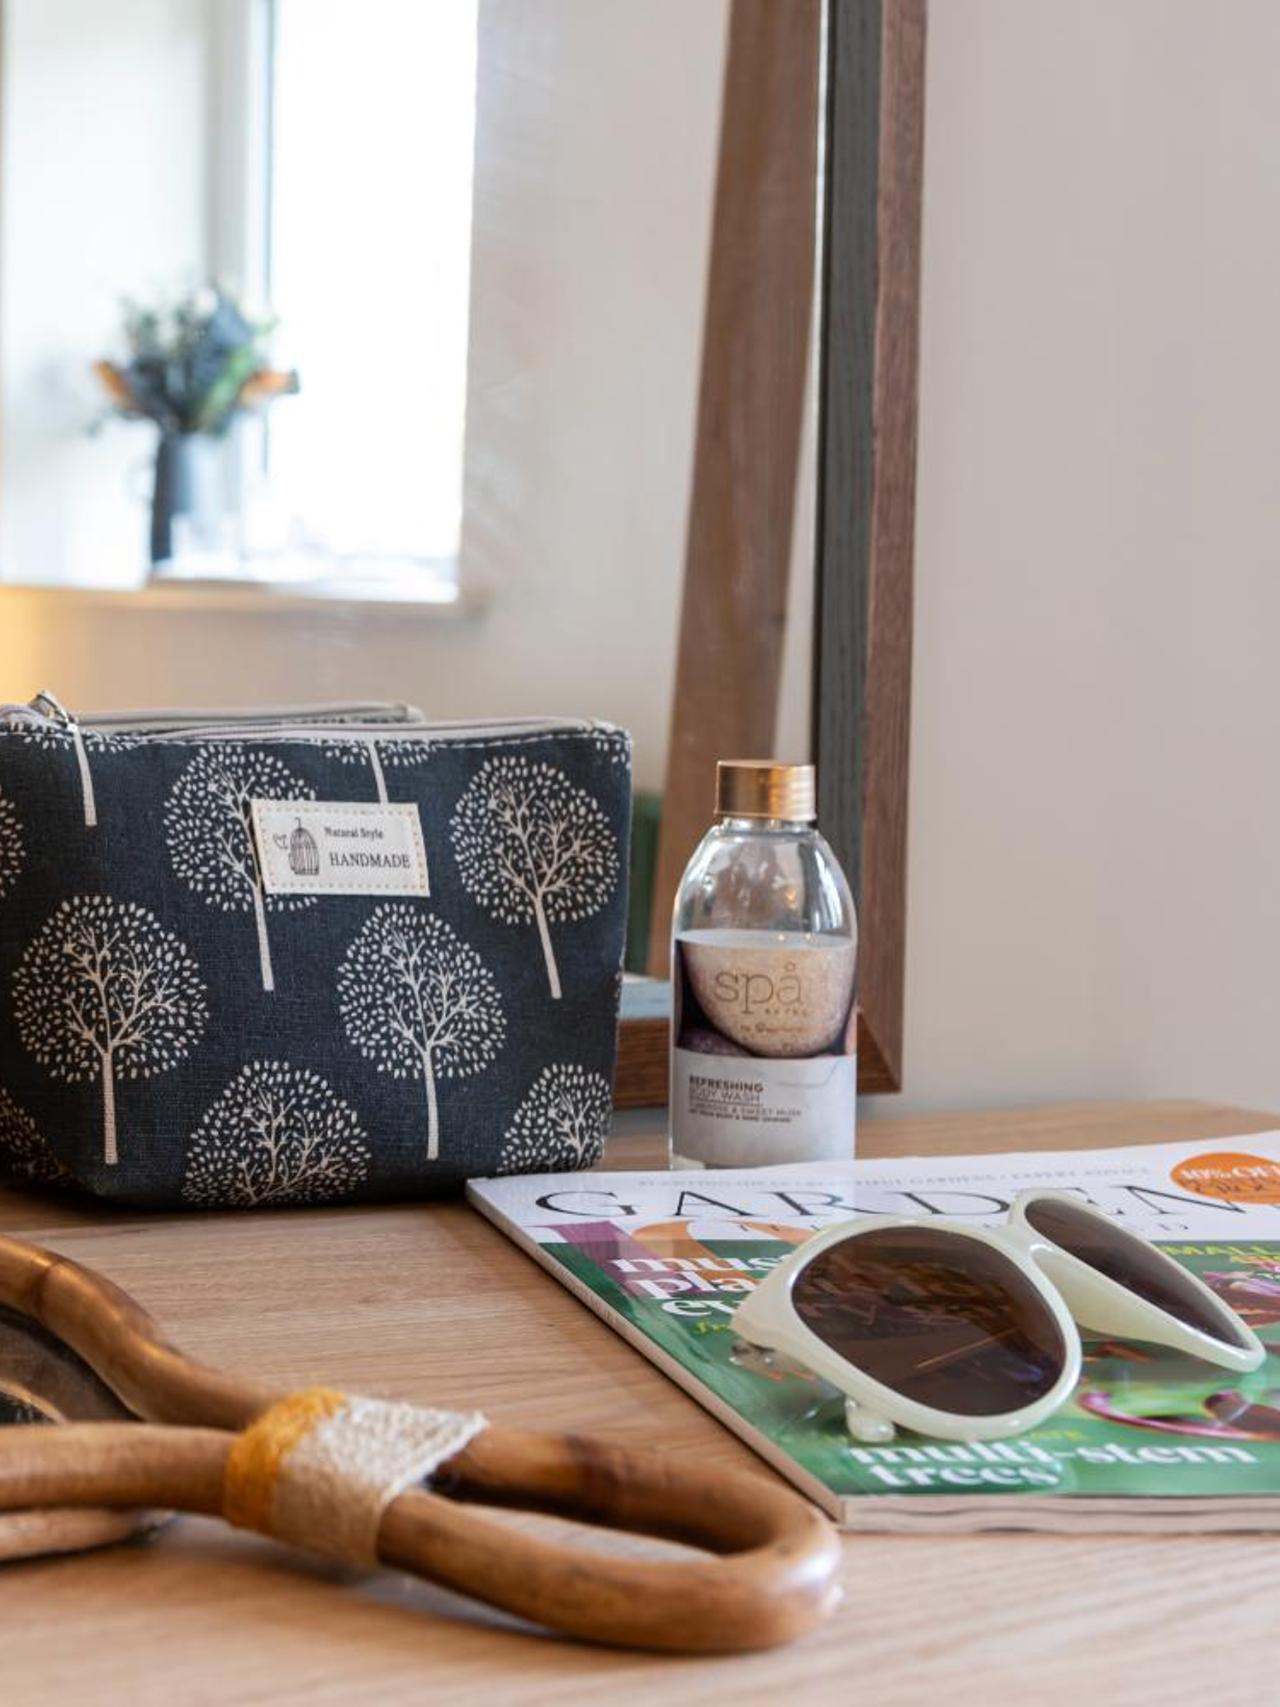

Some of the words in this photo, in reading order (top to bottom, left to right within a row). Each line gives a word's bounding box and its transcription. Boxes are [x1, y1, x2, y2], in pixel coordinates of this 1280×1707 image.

[323, 826, 358, 838] Natural
[360, 827, 384, 839] Style
[329, 852, 411, 869] HANDMADE
[848, 1441, 1258, 1465] multi-stem
[868, 1464, 1060, 1487] trees
